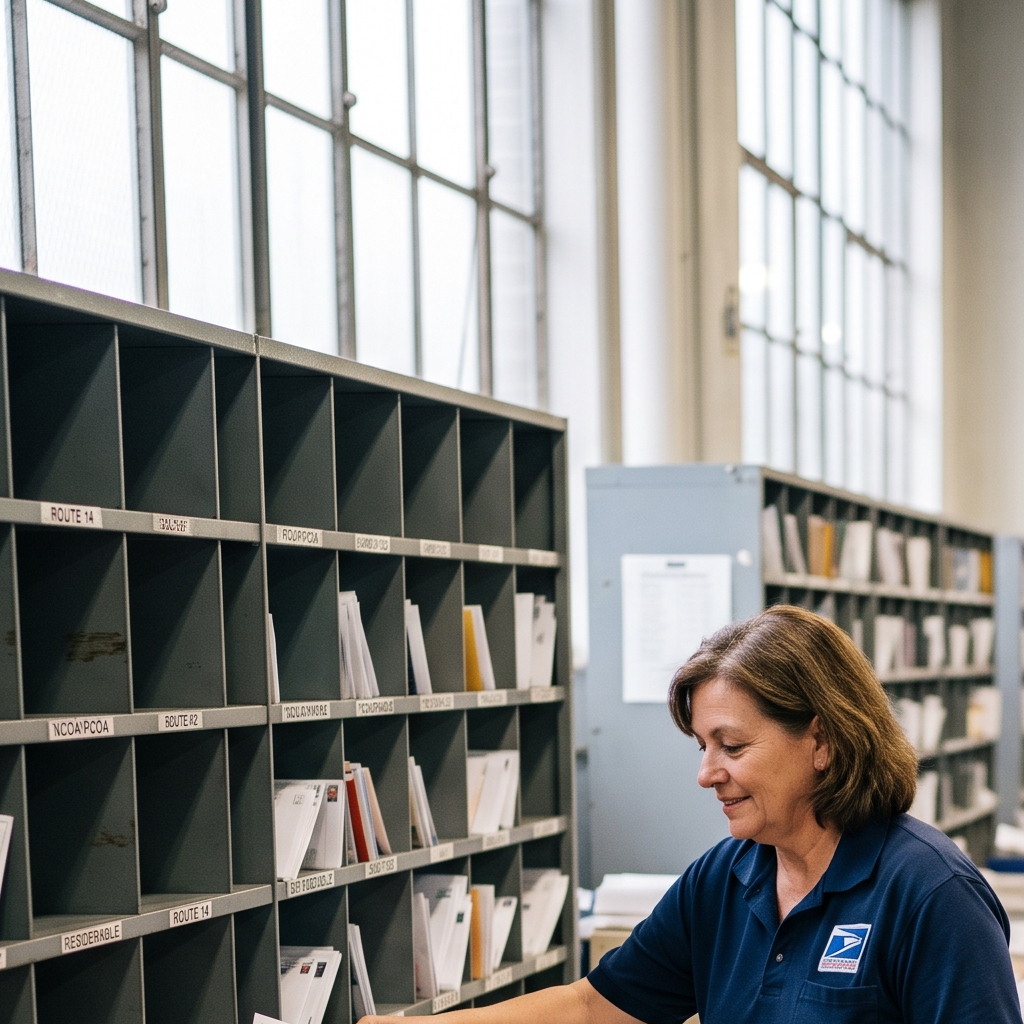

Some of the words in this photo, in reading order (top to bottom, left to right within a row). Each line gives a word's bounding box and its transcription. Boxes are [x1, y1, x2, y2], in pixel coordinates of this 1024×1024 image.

[51, 506, 81, 523] ROUTE
[173, 906, 199, 924] ROUTE
[201, 904, 209, 918] 14
